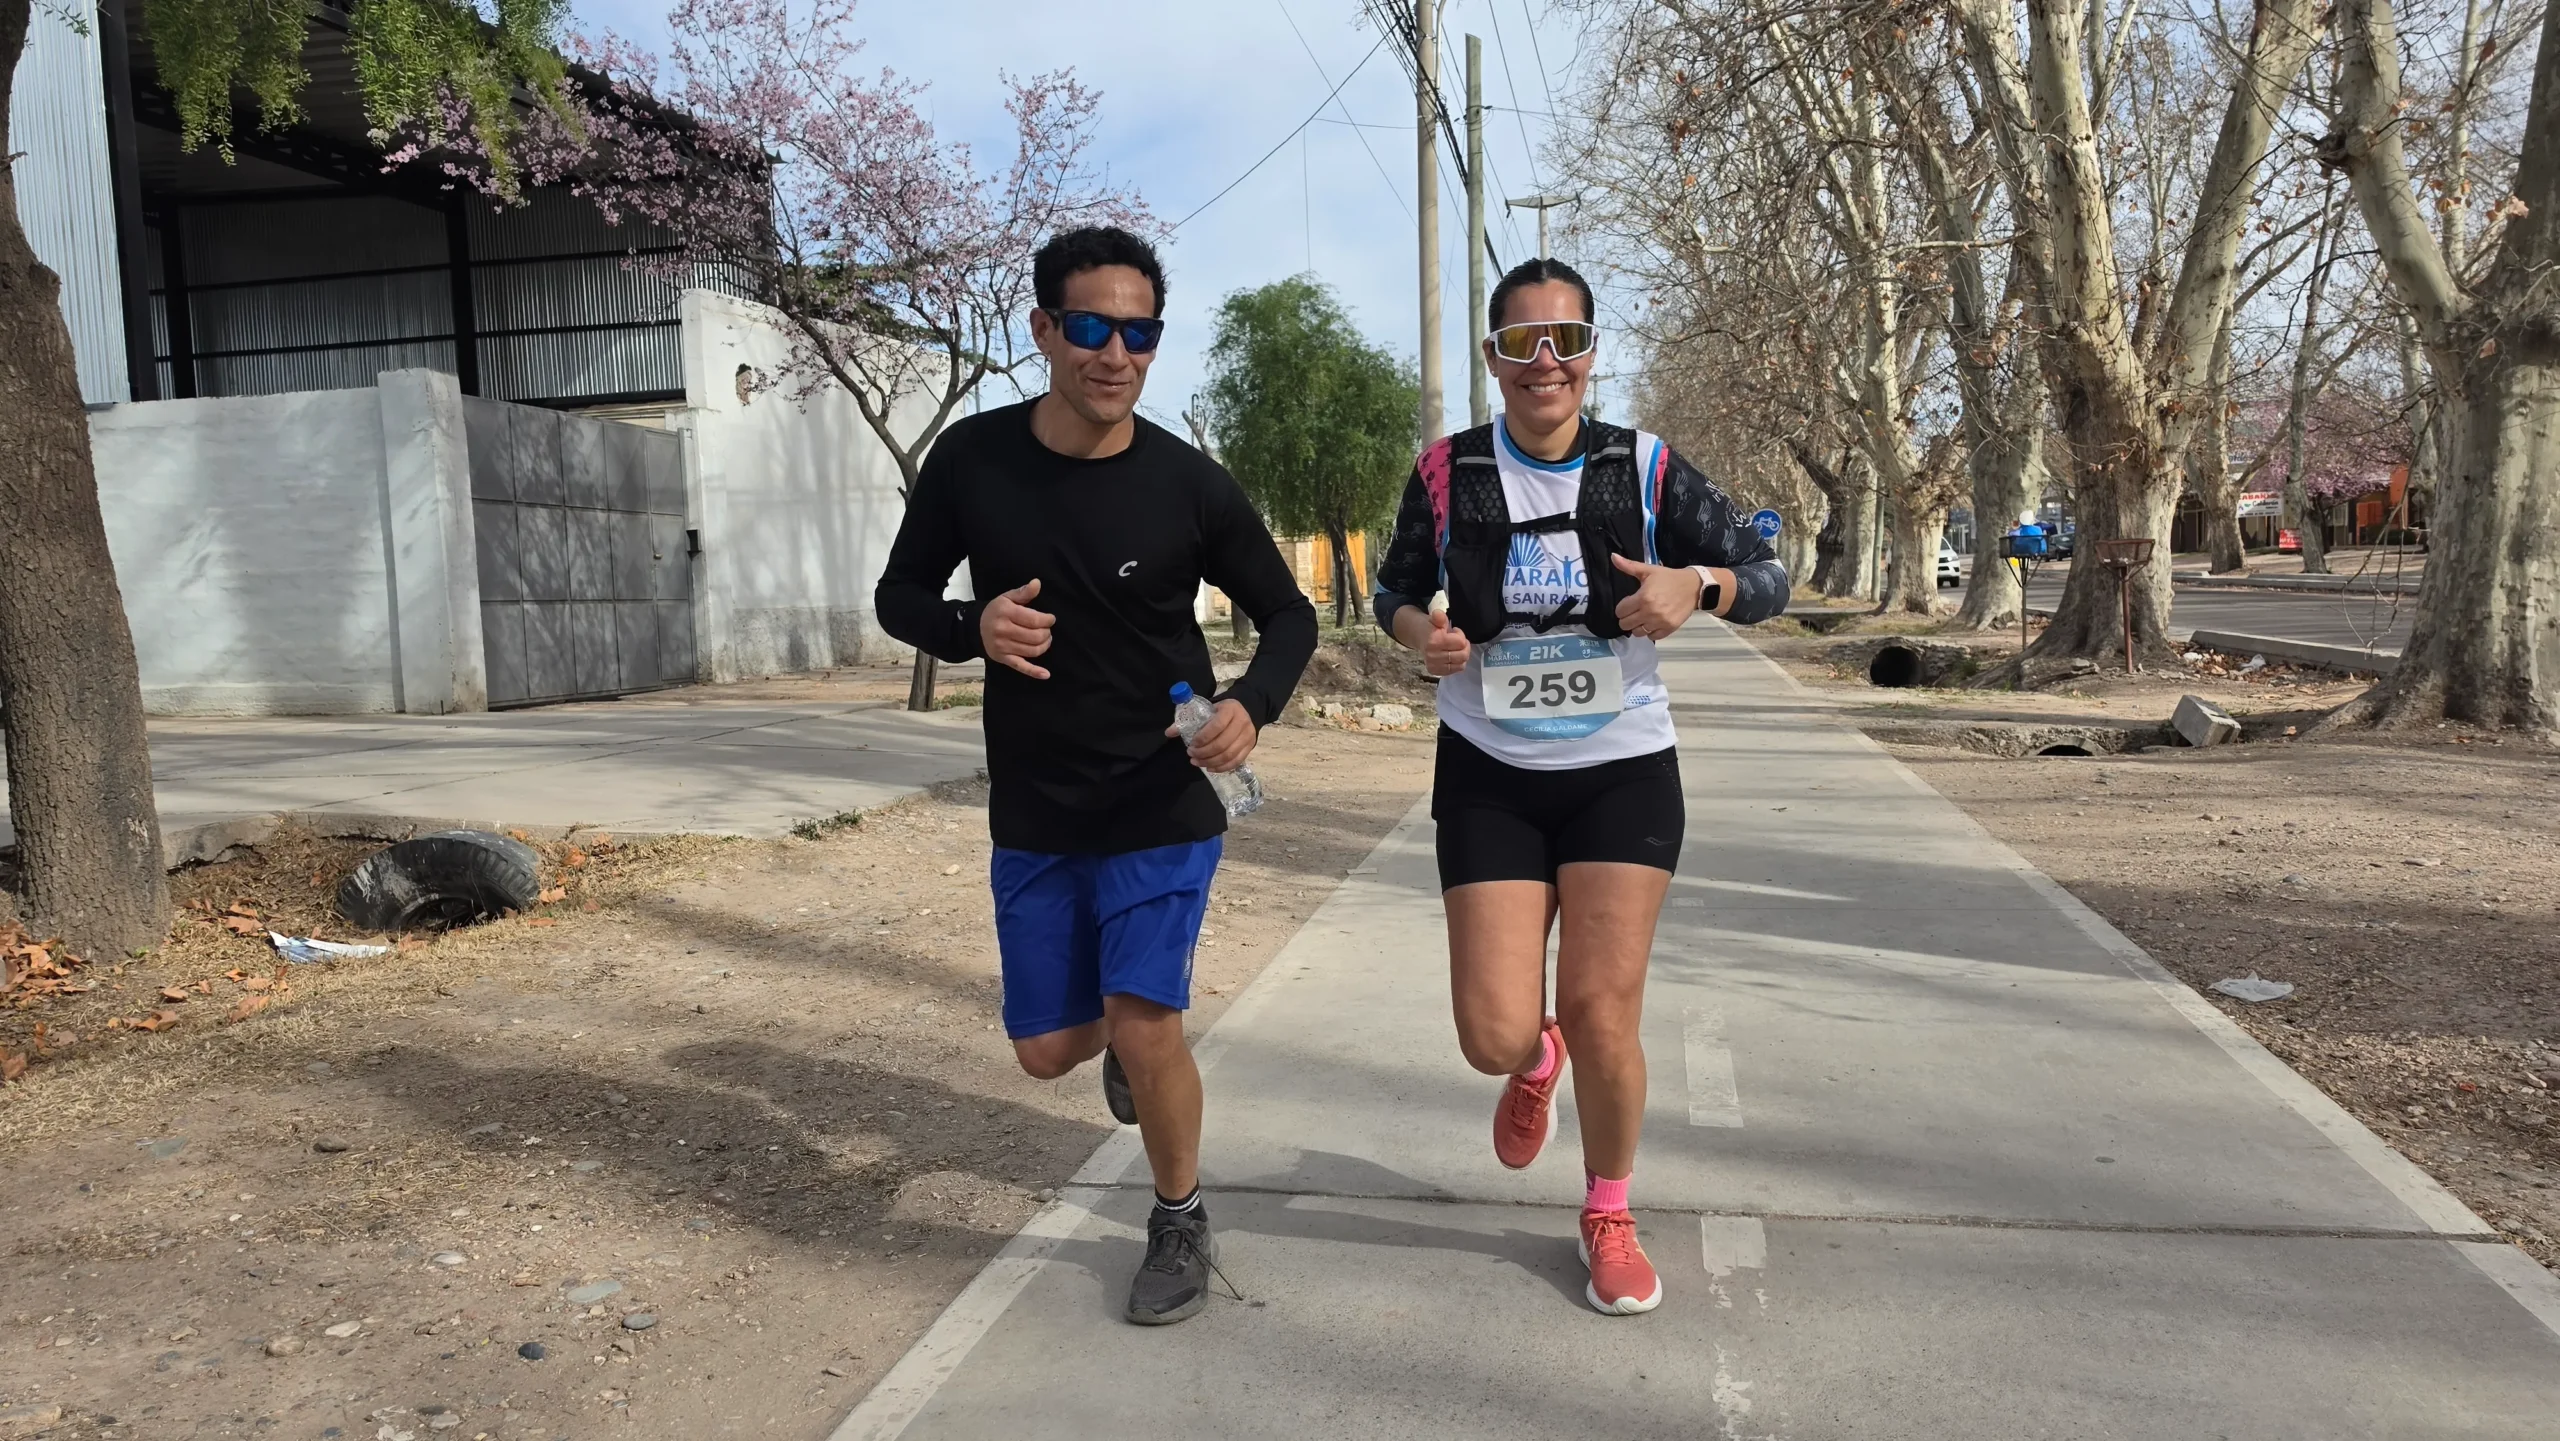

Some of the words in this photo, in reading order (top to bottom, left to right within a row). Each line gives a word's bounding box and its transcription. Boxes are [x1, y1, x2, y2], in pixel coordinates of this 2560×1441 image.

[1503, 566, 1589, 589] ARATO
[1512, 593, 1545, 605] SAN
[1549, 594, 1589, 606] RAFA
[1529, 643, 1565, 660] 21K
[1507, 669, 1597, 709] 259
[1553, 723, 1589, 732] GALDAME
